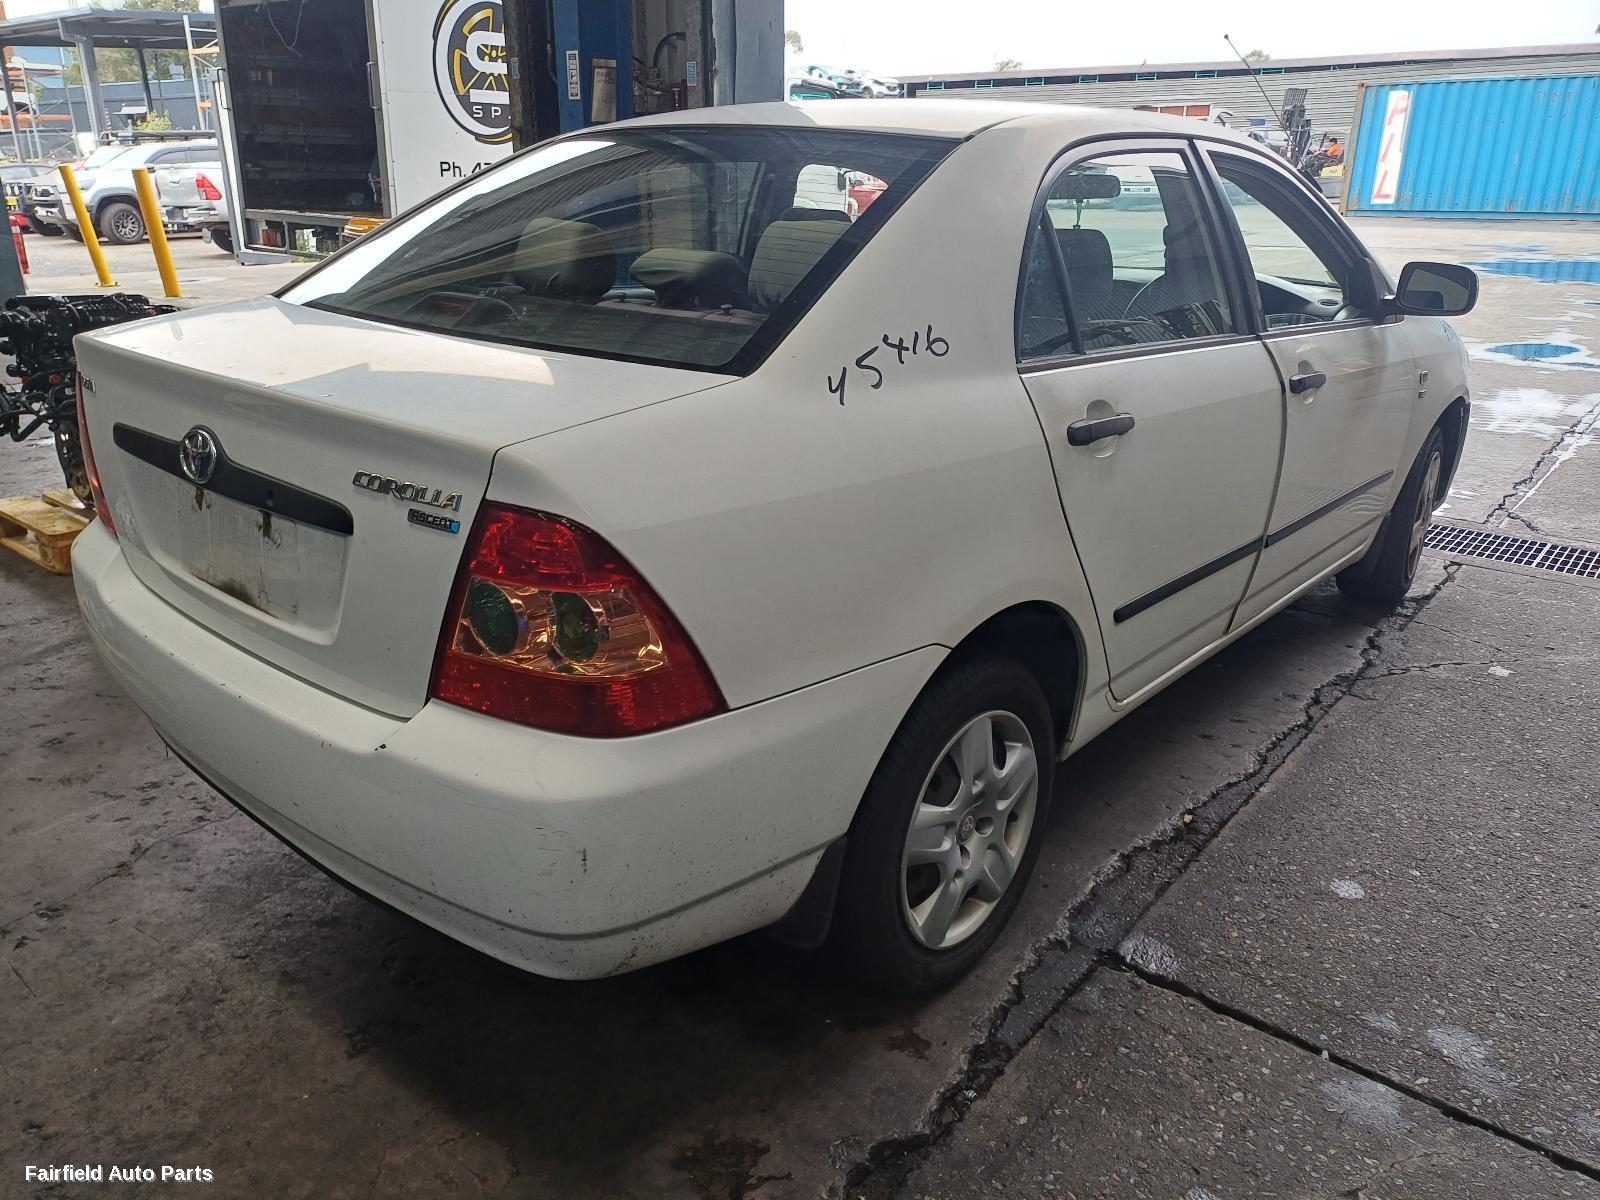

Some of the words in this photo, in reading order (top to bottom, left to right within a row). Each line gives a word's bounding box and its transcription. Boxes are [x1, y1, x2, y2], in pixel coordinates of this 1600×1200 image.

[472, 105, 512, 119] SP
[440, 161, 466, 178] Ph.
[352, 469, 462, 512] COROLLA
[409, 508, 459, 533] ASCENT
